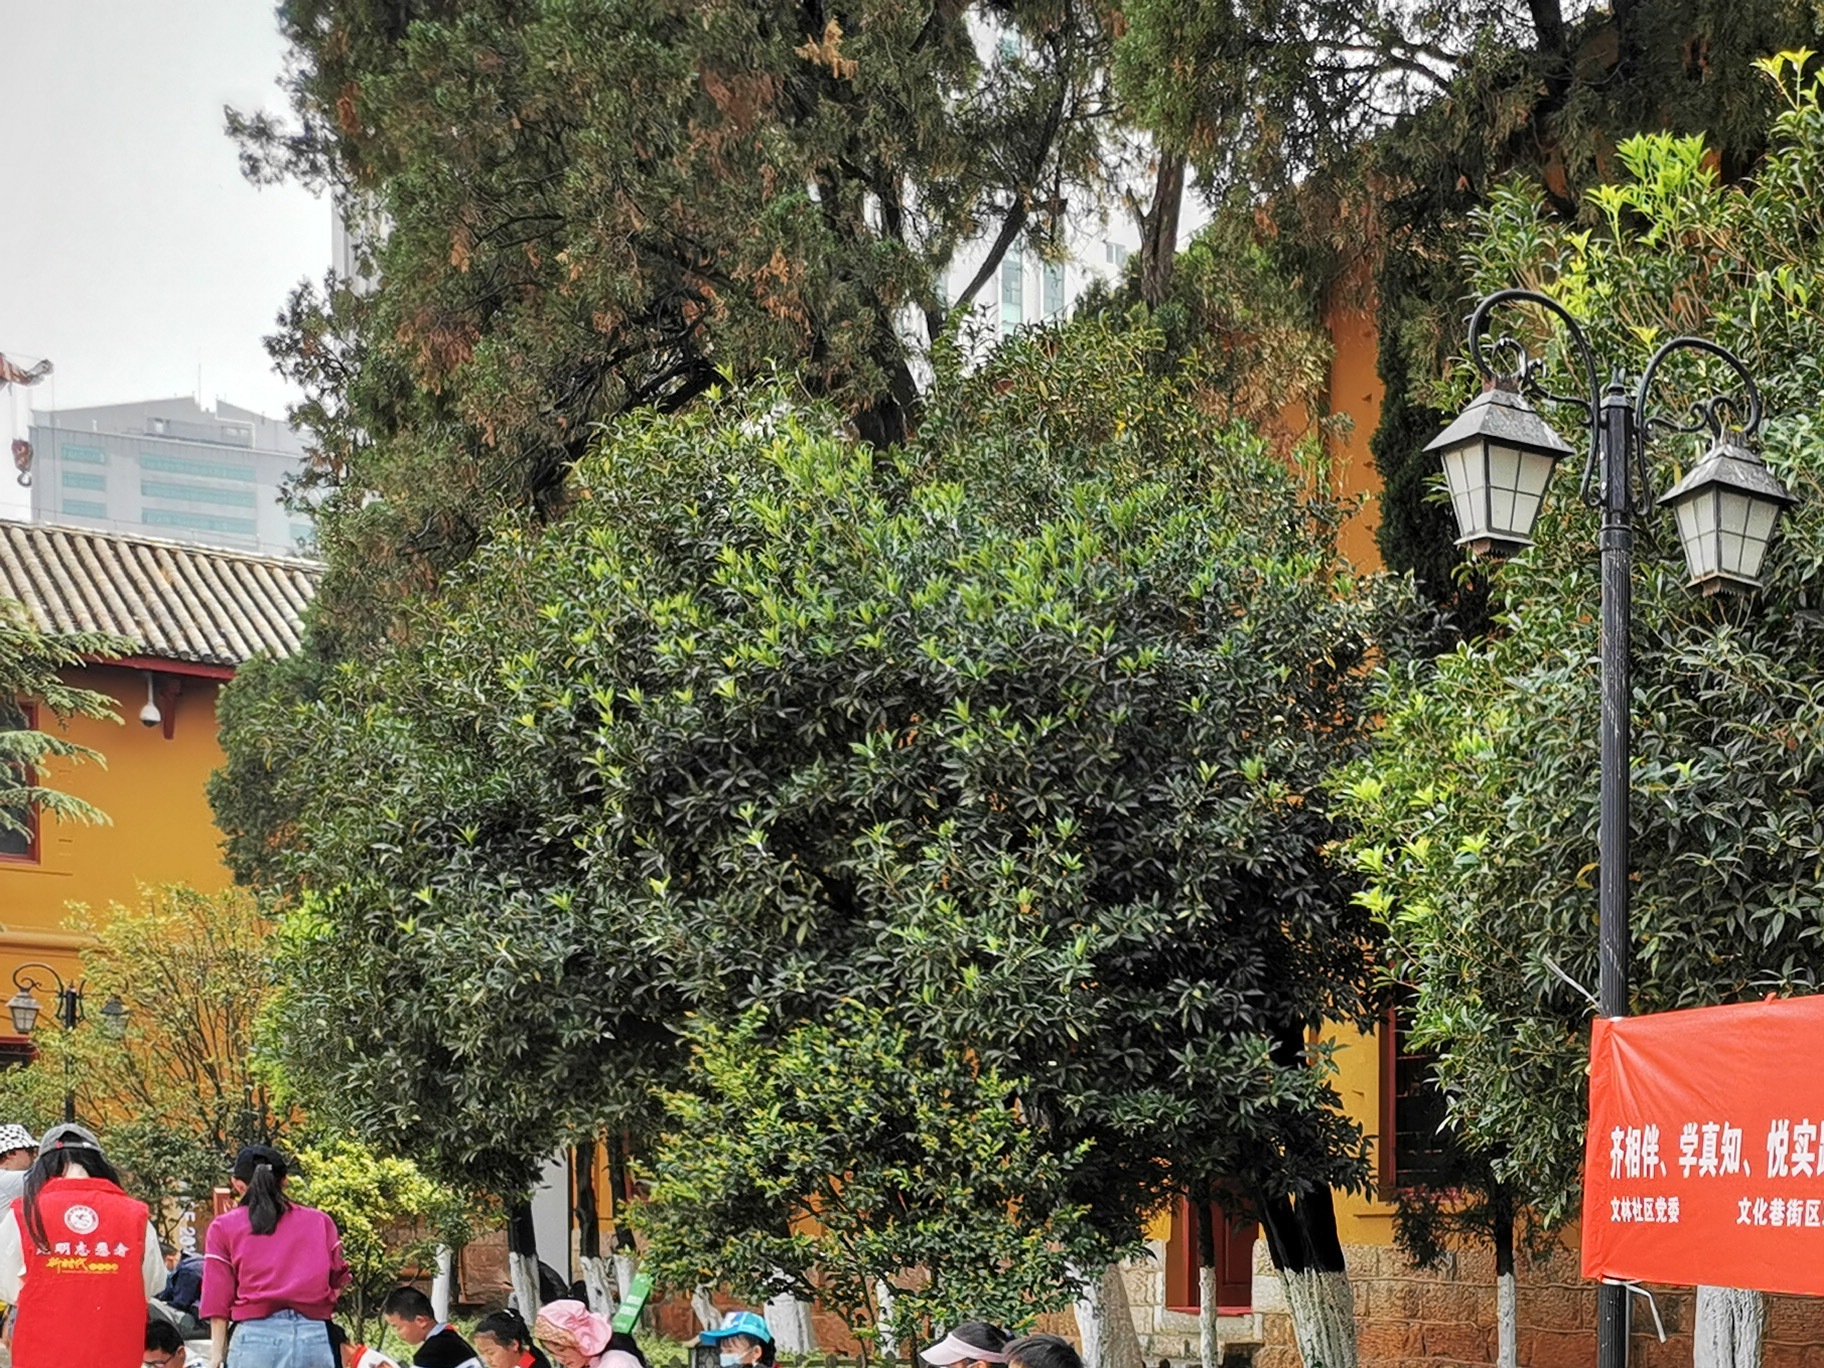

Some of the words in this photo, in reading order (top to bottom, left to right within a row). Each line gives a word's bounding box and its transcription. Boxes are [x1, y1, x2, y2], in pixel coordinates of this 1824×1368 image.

[1610, 1195, 1680, 1223] 文林社区党委
